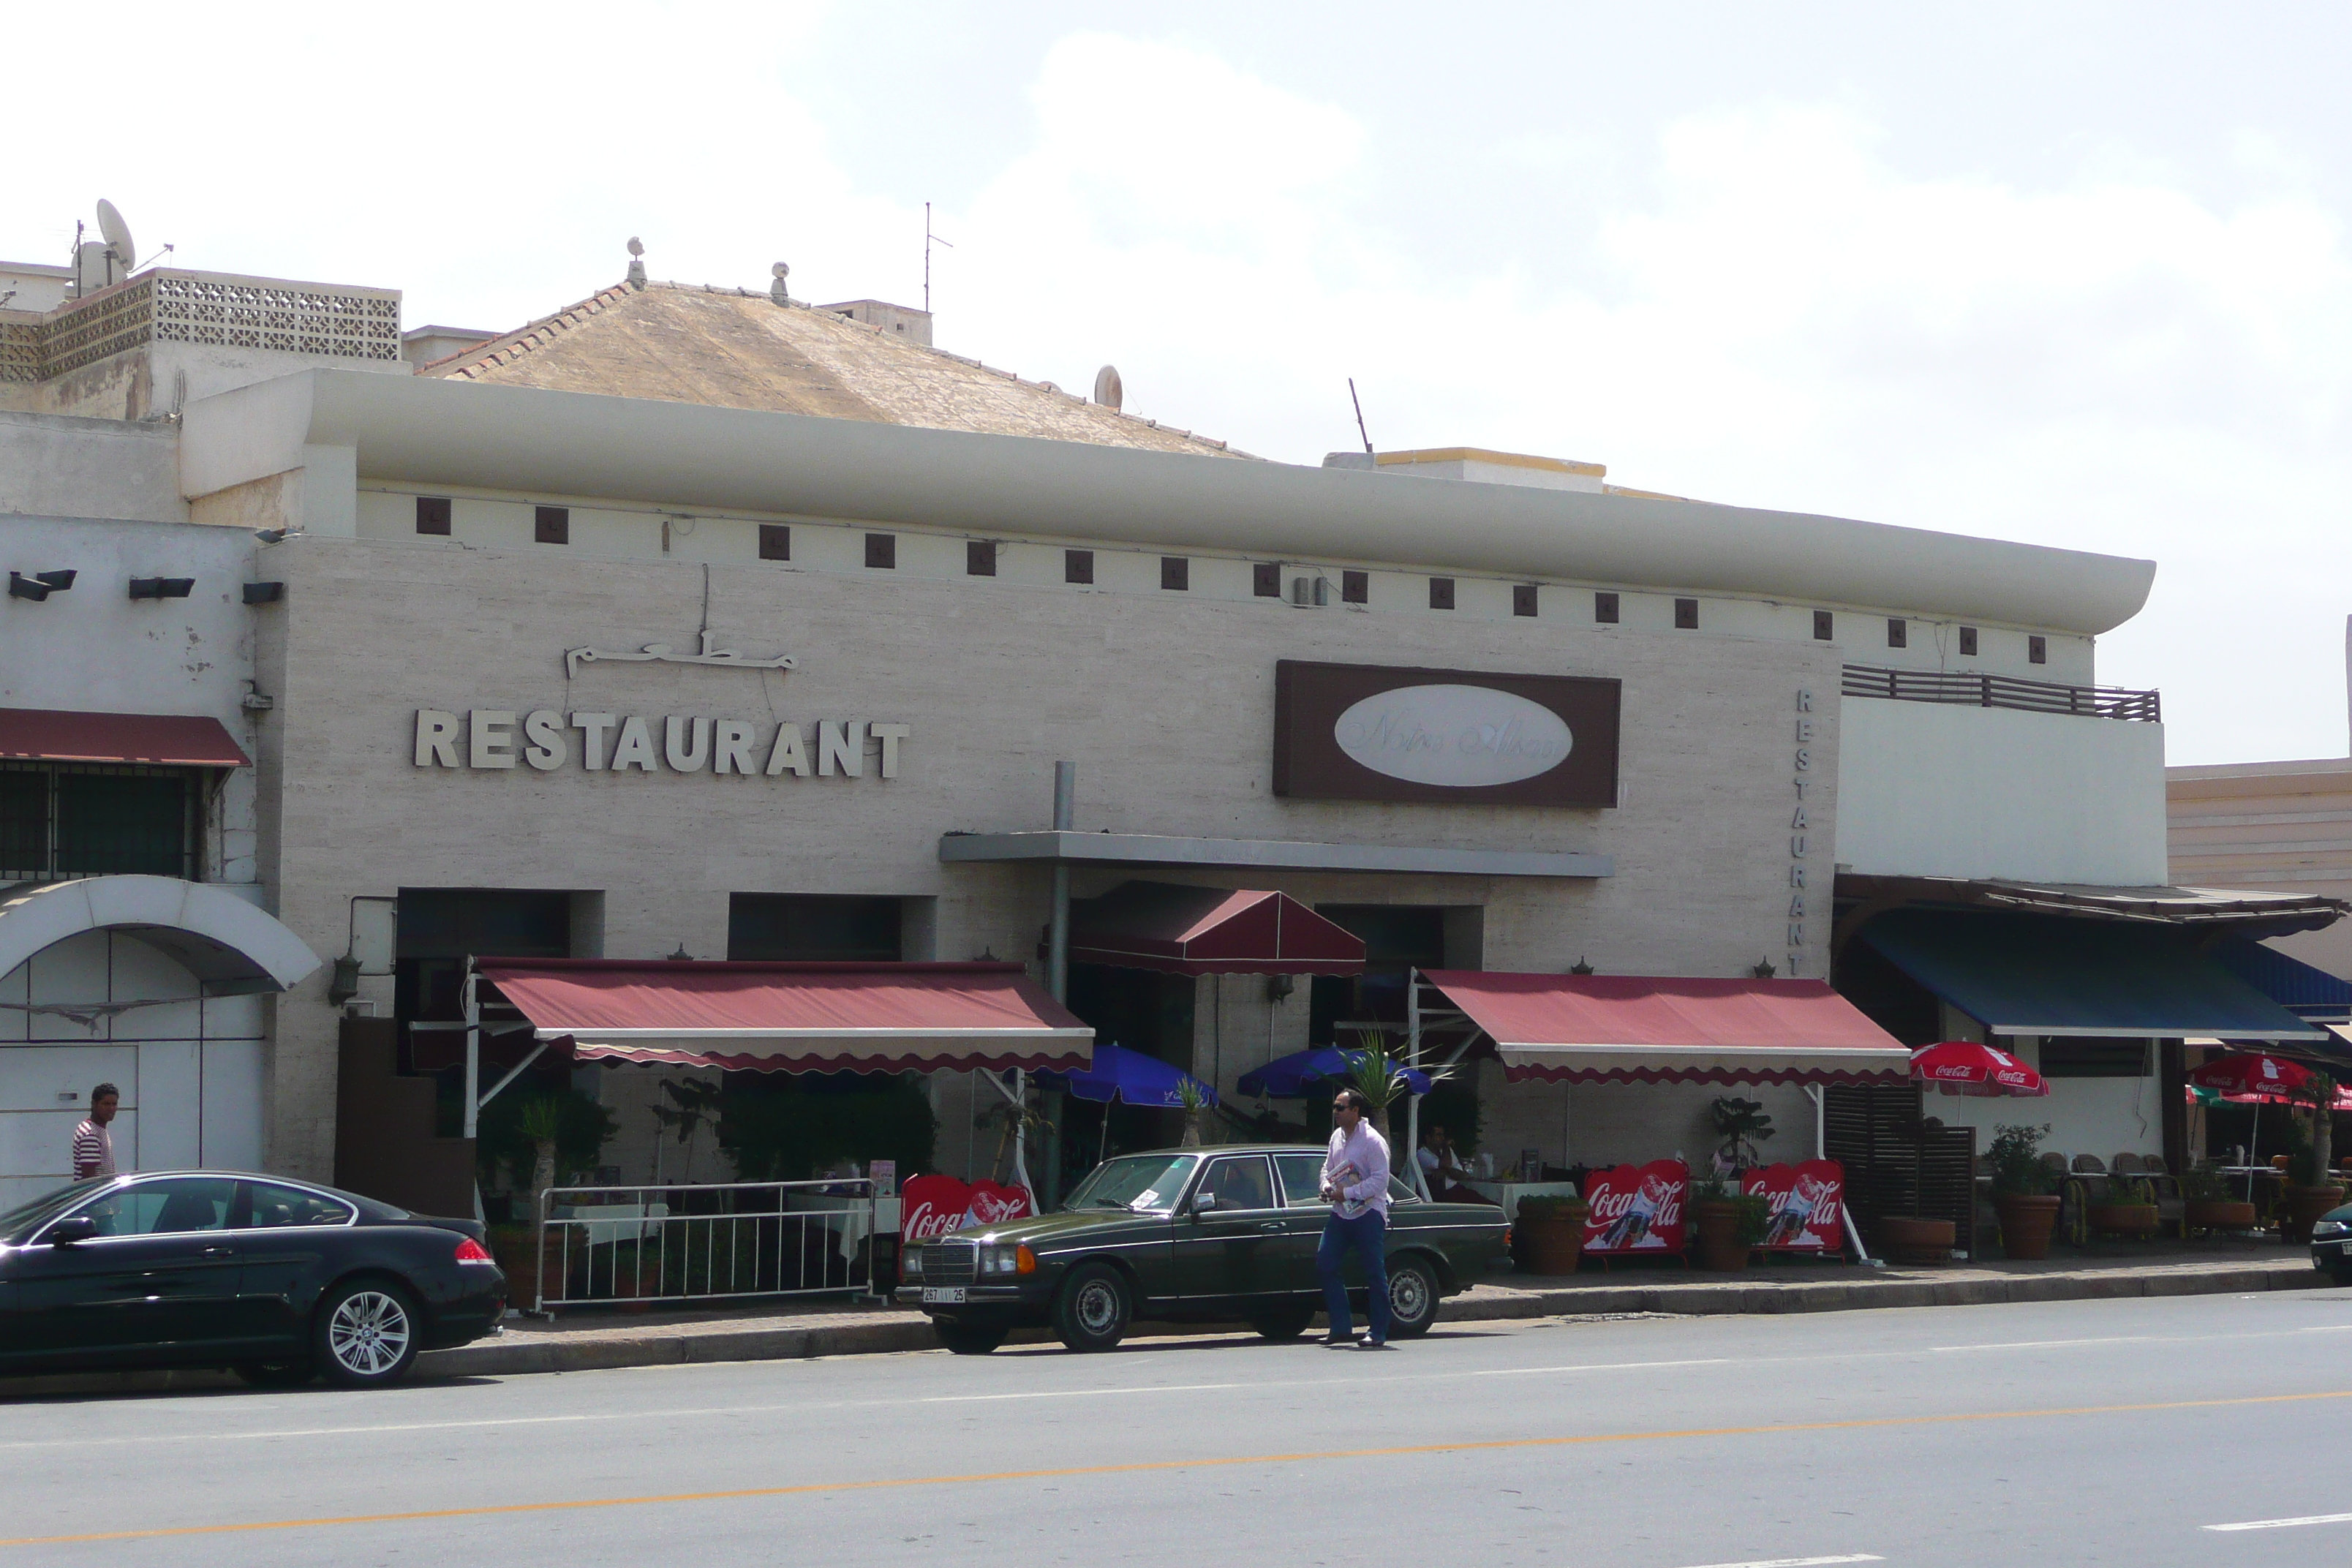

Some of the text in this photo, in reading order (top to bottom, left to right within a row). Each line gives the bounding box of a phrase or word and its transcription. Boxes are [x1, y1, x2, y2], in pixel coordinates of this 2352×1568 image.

[563, 629, 799, 679] مطعم
[414, 708, 911, 780] RESTAURANT
[1787, 689, 1813, 976] RESTAURANT
[1749, 1180, 1840, 1225] ca-ola
[924, 1289, 938, 1301] 267
[954, 1289, 963, 1301] 25
